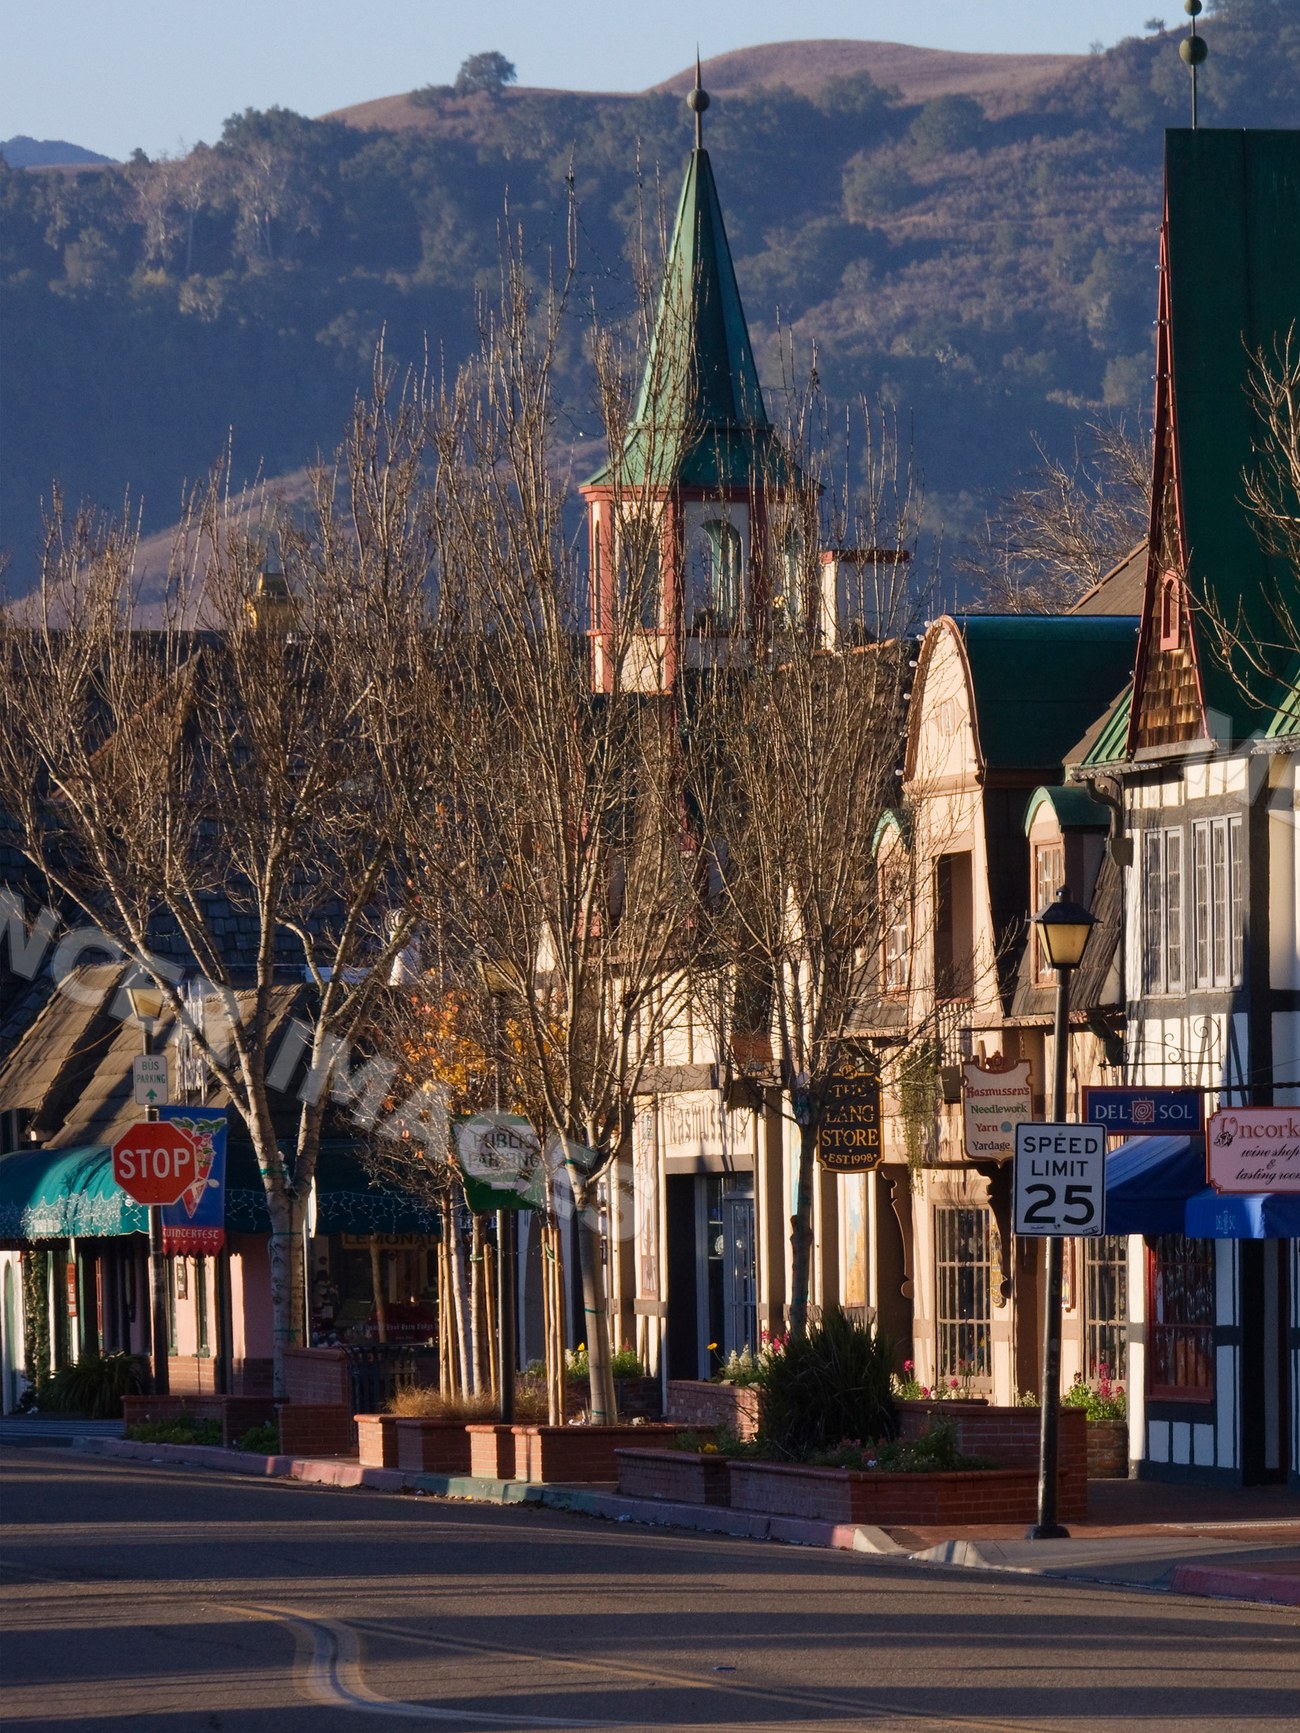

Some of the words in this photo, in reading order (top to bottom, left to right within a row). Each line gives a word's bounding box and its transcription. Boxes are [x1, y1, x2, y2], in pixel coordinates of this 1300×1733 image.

[141, 1061, 160, 1071] BUS
[136, 1074, 166, 1084] PARKING
[965, 1086, 1030, 1098] Rasmussen's
[825, 1104, 874, 1123] LANG
[970, 1103, 1028, 1114] Needlework
[1095, 1104, 1128, 1119] DEL
[1159, 1104, 1193, 1119] SOL
[975, 1122, 999, 1133] Yarn
[821, 1128, 879, 1146] STORE
[1023, 1136, 1098, 1153] SPEED
[971, 1140, 1011, 1152] Yardage
[1241, 1145, 1271, 1157] wine
[1271, 1143, 1300, 1161] shop
[119, 1147, 190, 1179] STOP
[1031, 1160, 1089, 1177] LIMIT
[1235, 1167, 1277, 1185] tasting
[1023, 1183, 1096, 1226] 25
[162, 1228, 220, 1240] WINTERFEST
